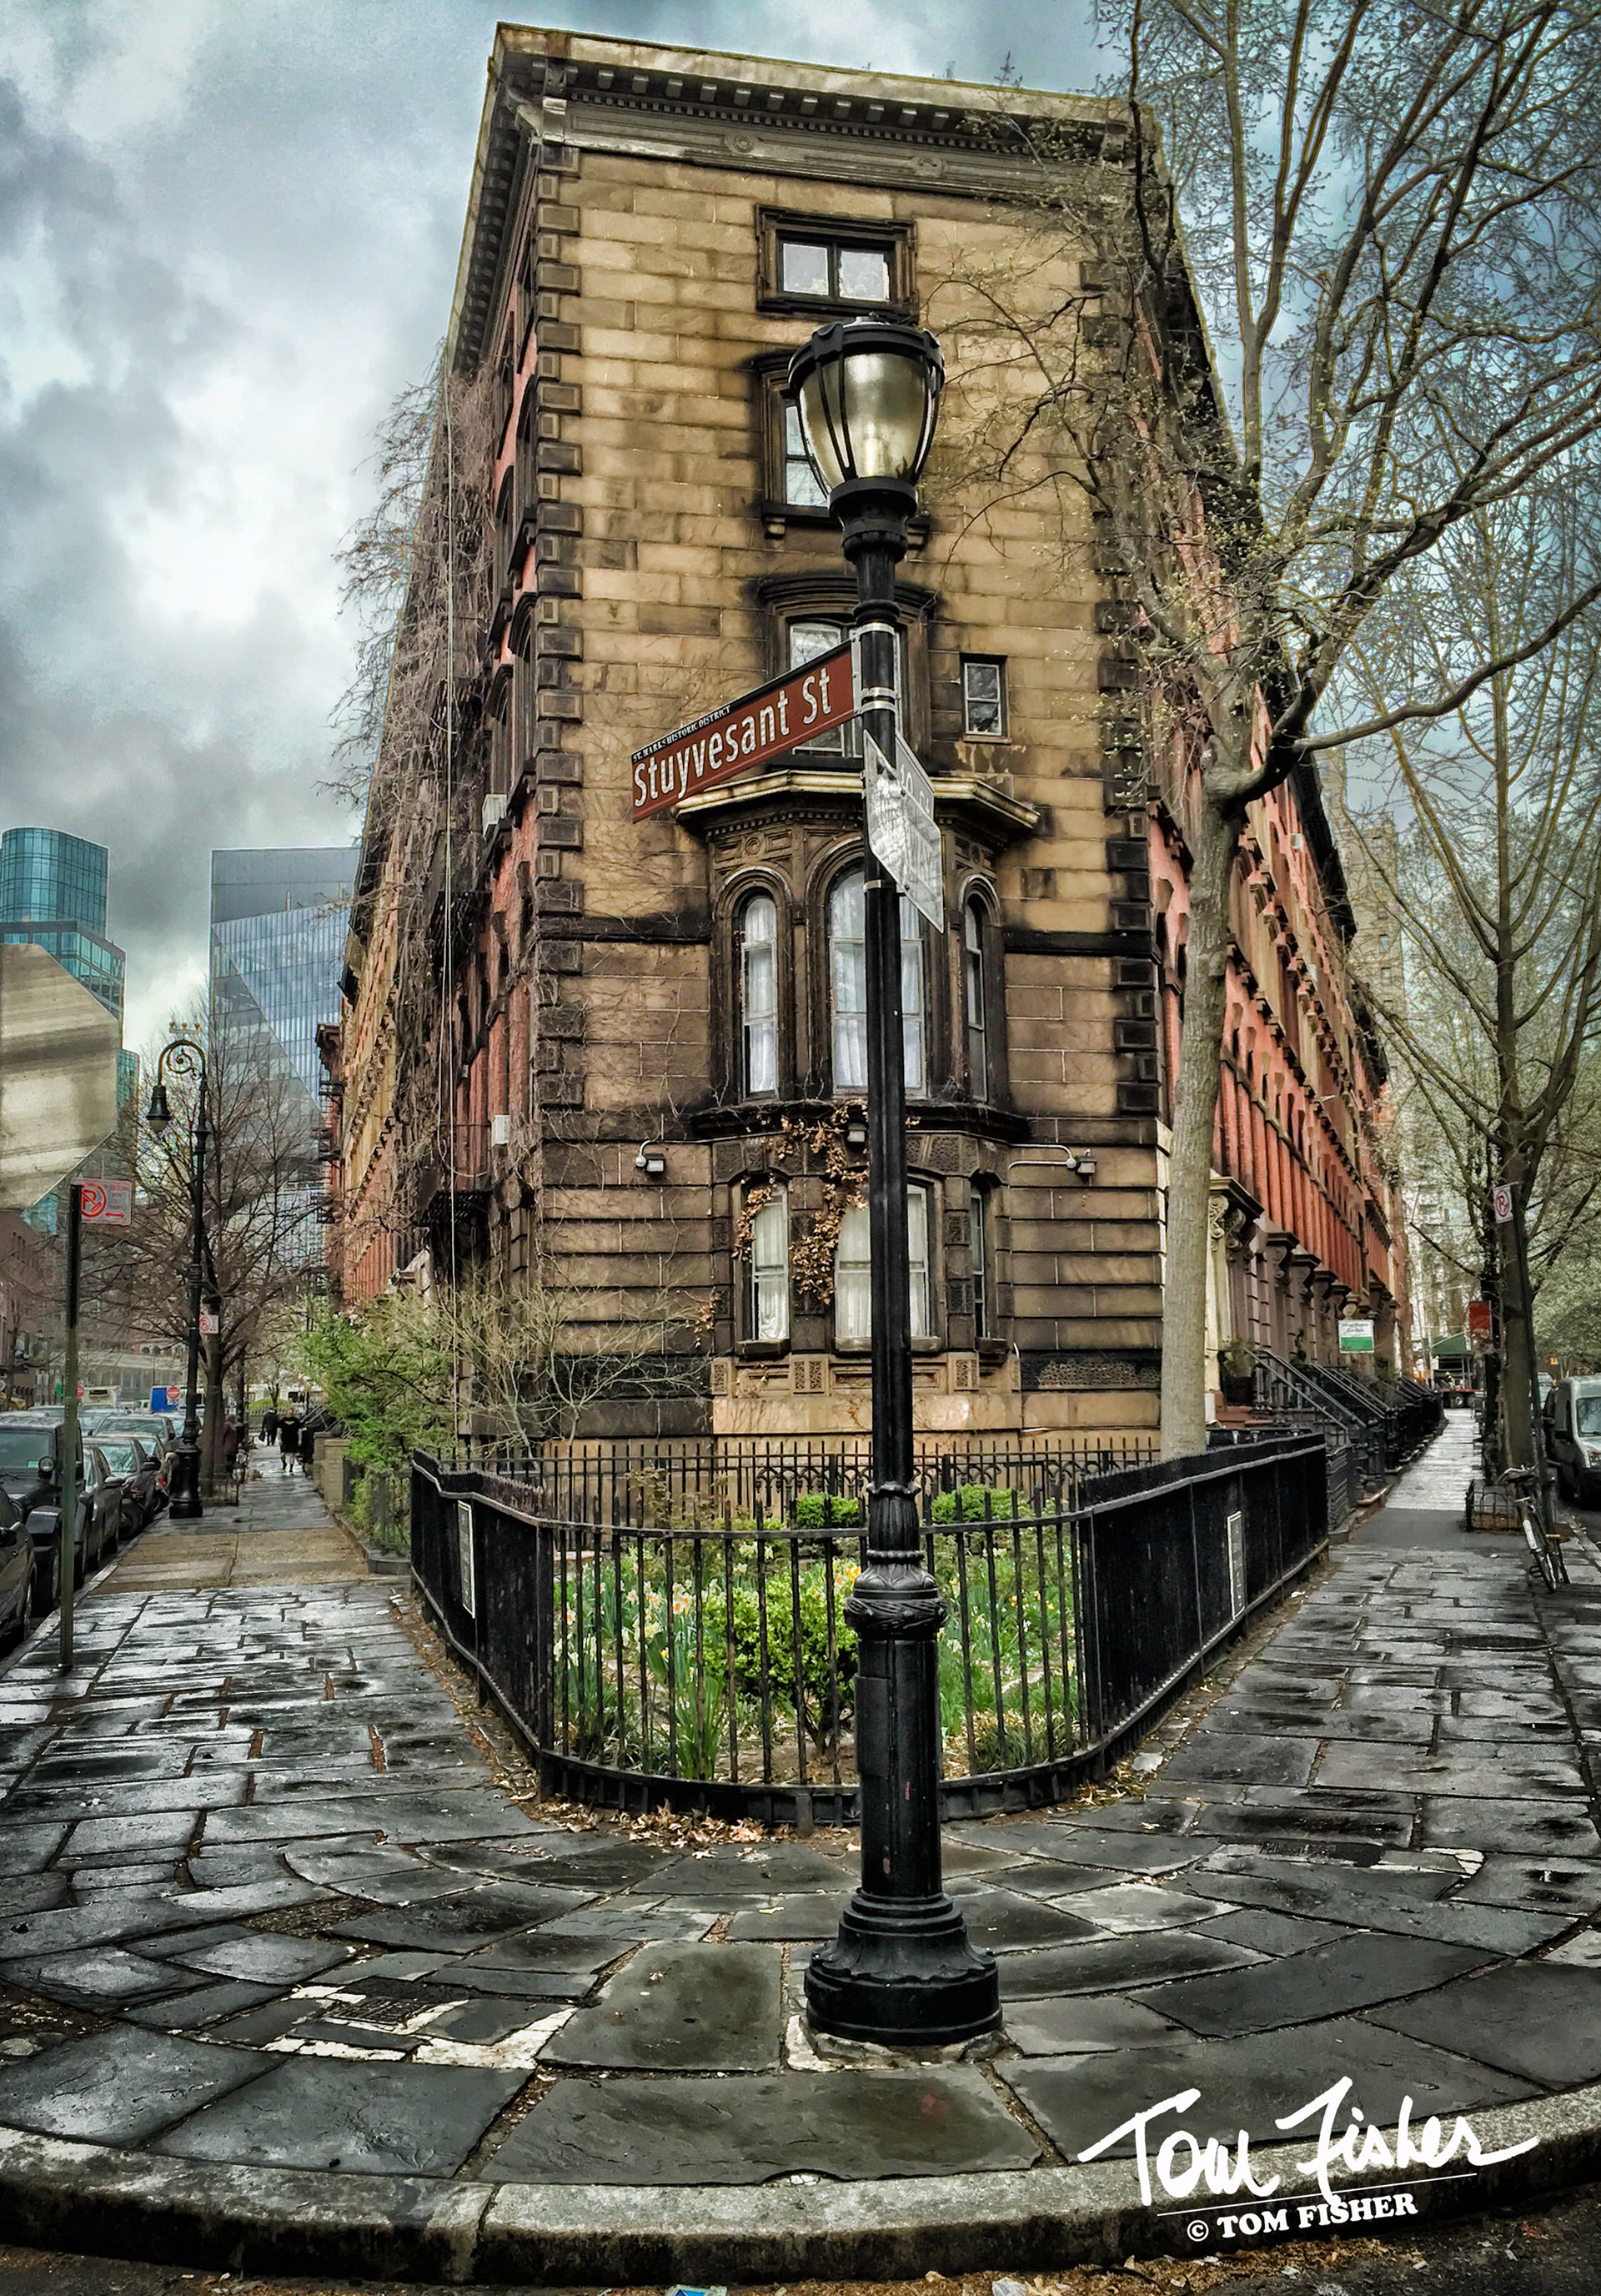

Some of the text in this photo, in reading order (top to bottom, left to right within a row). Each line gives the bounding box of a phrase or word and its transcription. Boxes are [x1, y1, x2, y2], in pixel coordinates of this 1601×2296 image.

[634, 667, 831, 807] Stuyvesant St
[666, 722, 698, 744] HISTORIC
[698, 705, 731, 728] DISTRICT
